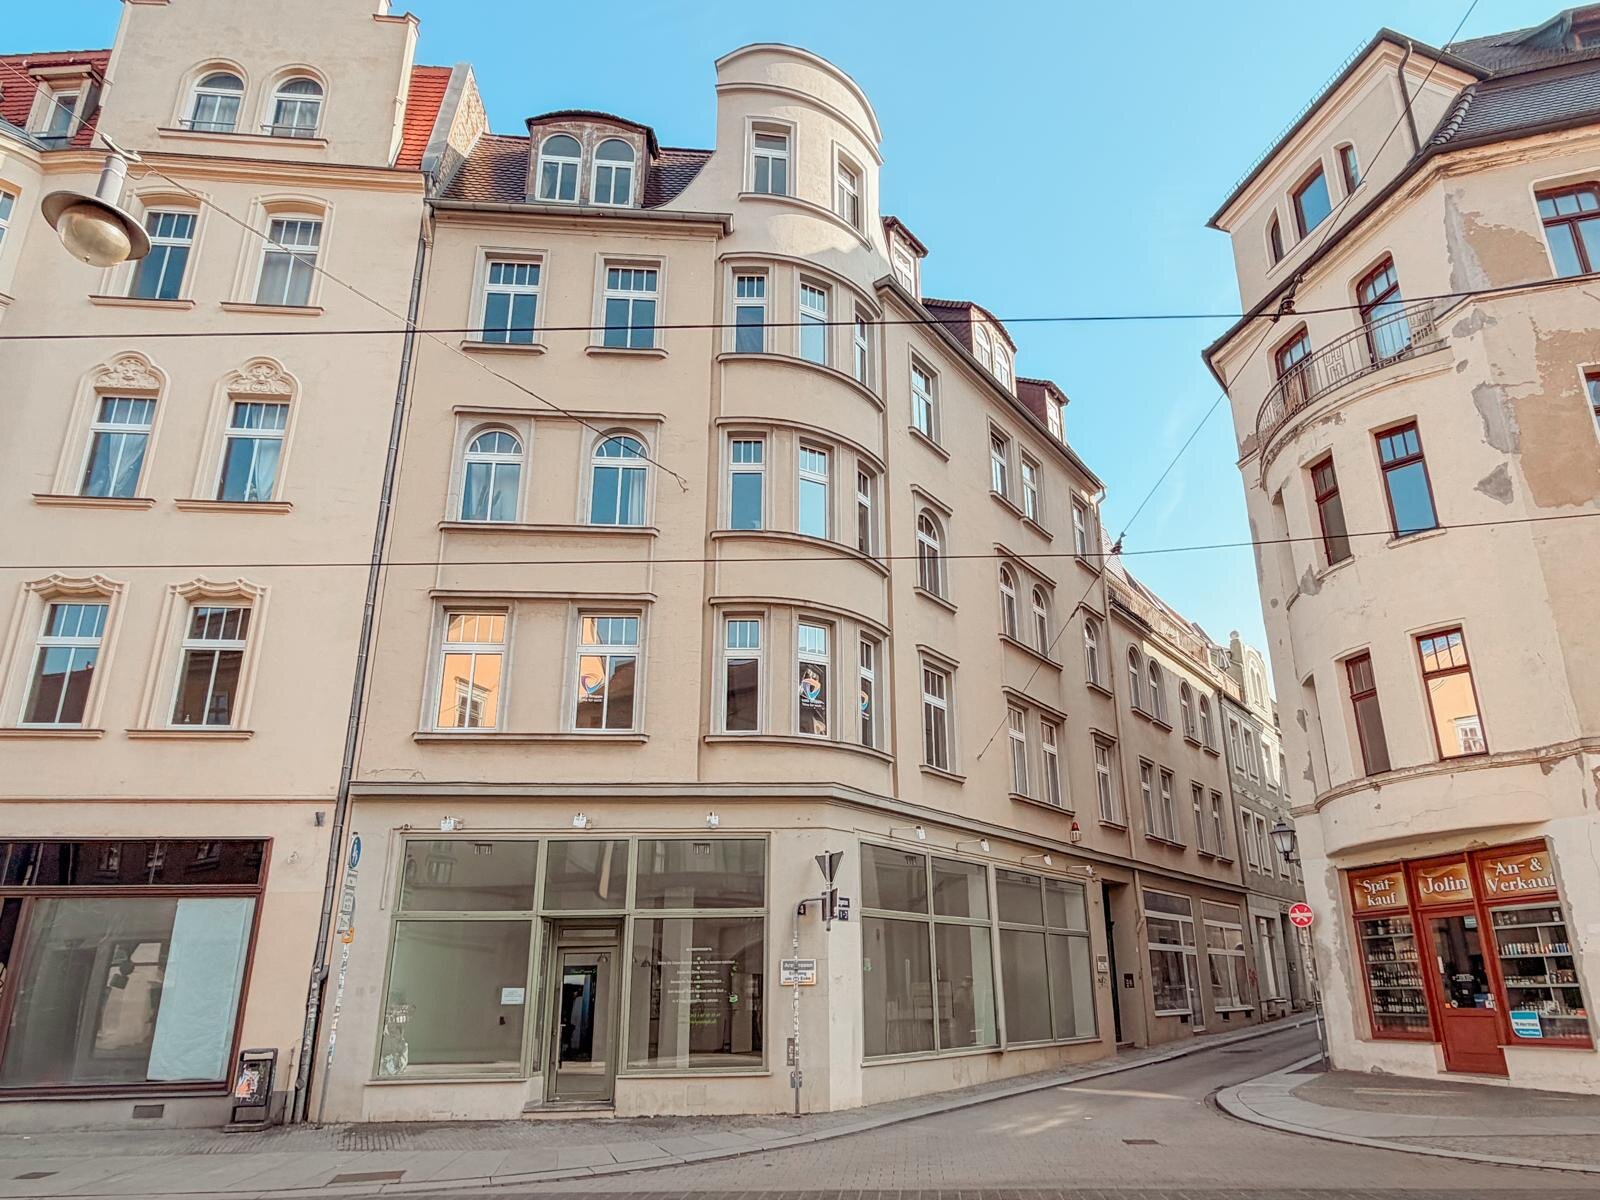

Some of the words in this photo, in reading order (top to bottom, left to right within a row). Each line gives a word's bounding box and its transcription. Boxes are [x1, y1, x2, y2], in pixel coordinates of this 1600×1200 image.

[1495, 862, 1525, 876] An-
[1529, 857, 1542, 871] &
[1362, 879, 1395, 894] Spät-
[1423, 876, 1468, 894] Jolin
[1487, 873, 1556, 892] Verkauf
[1367, 892, 1396, 906] kauf
